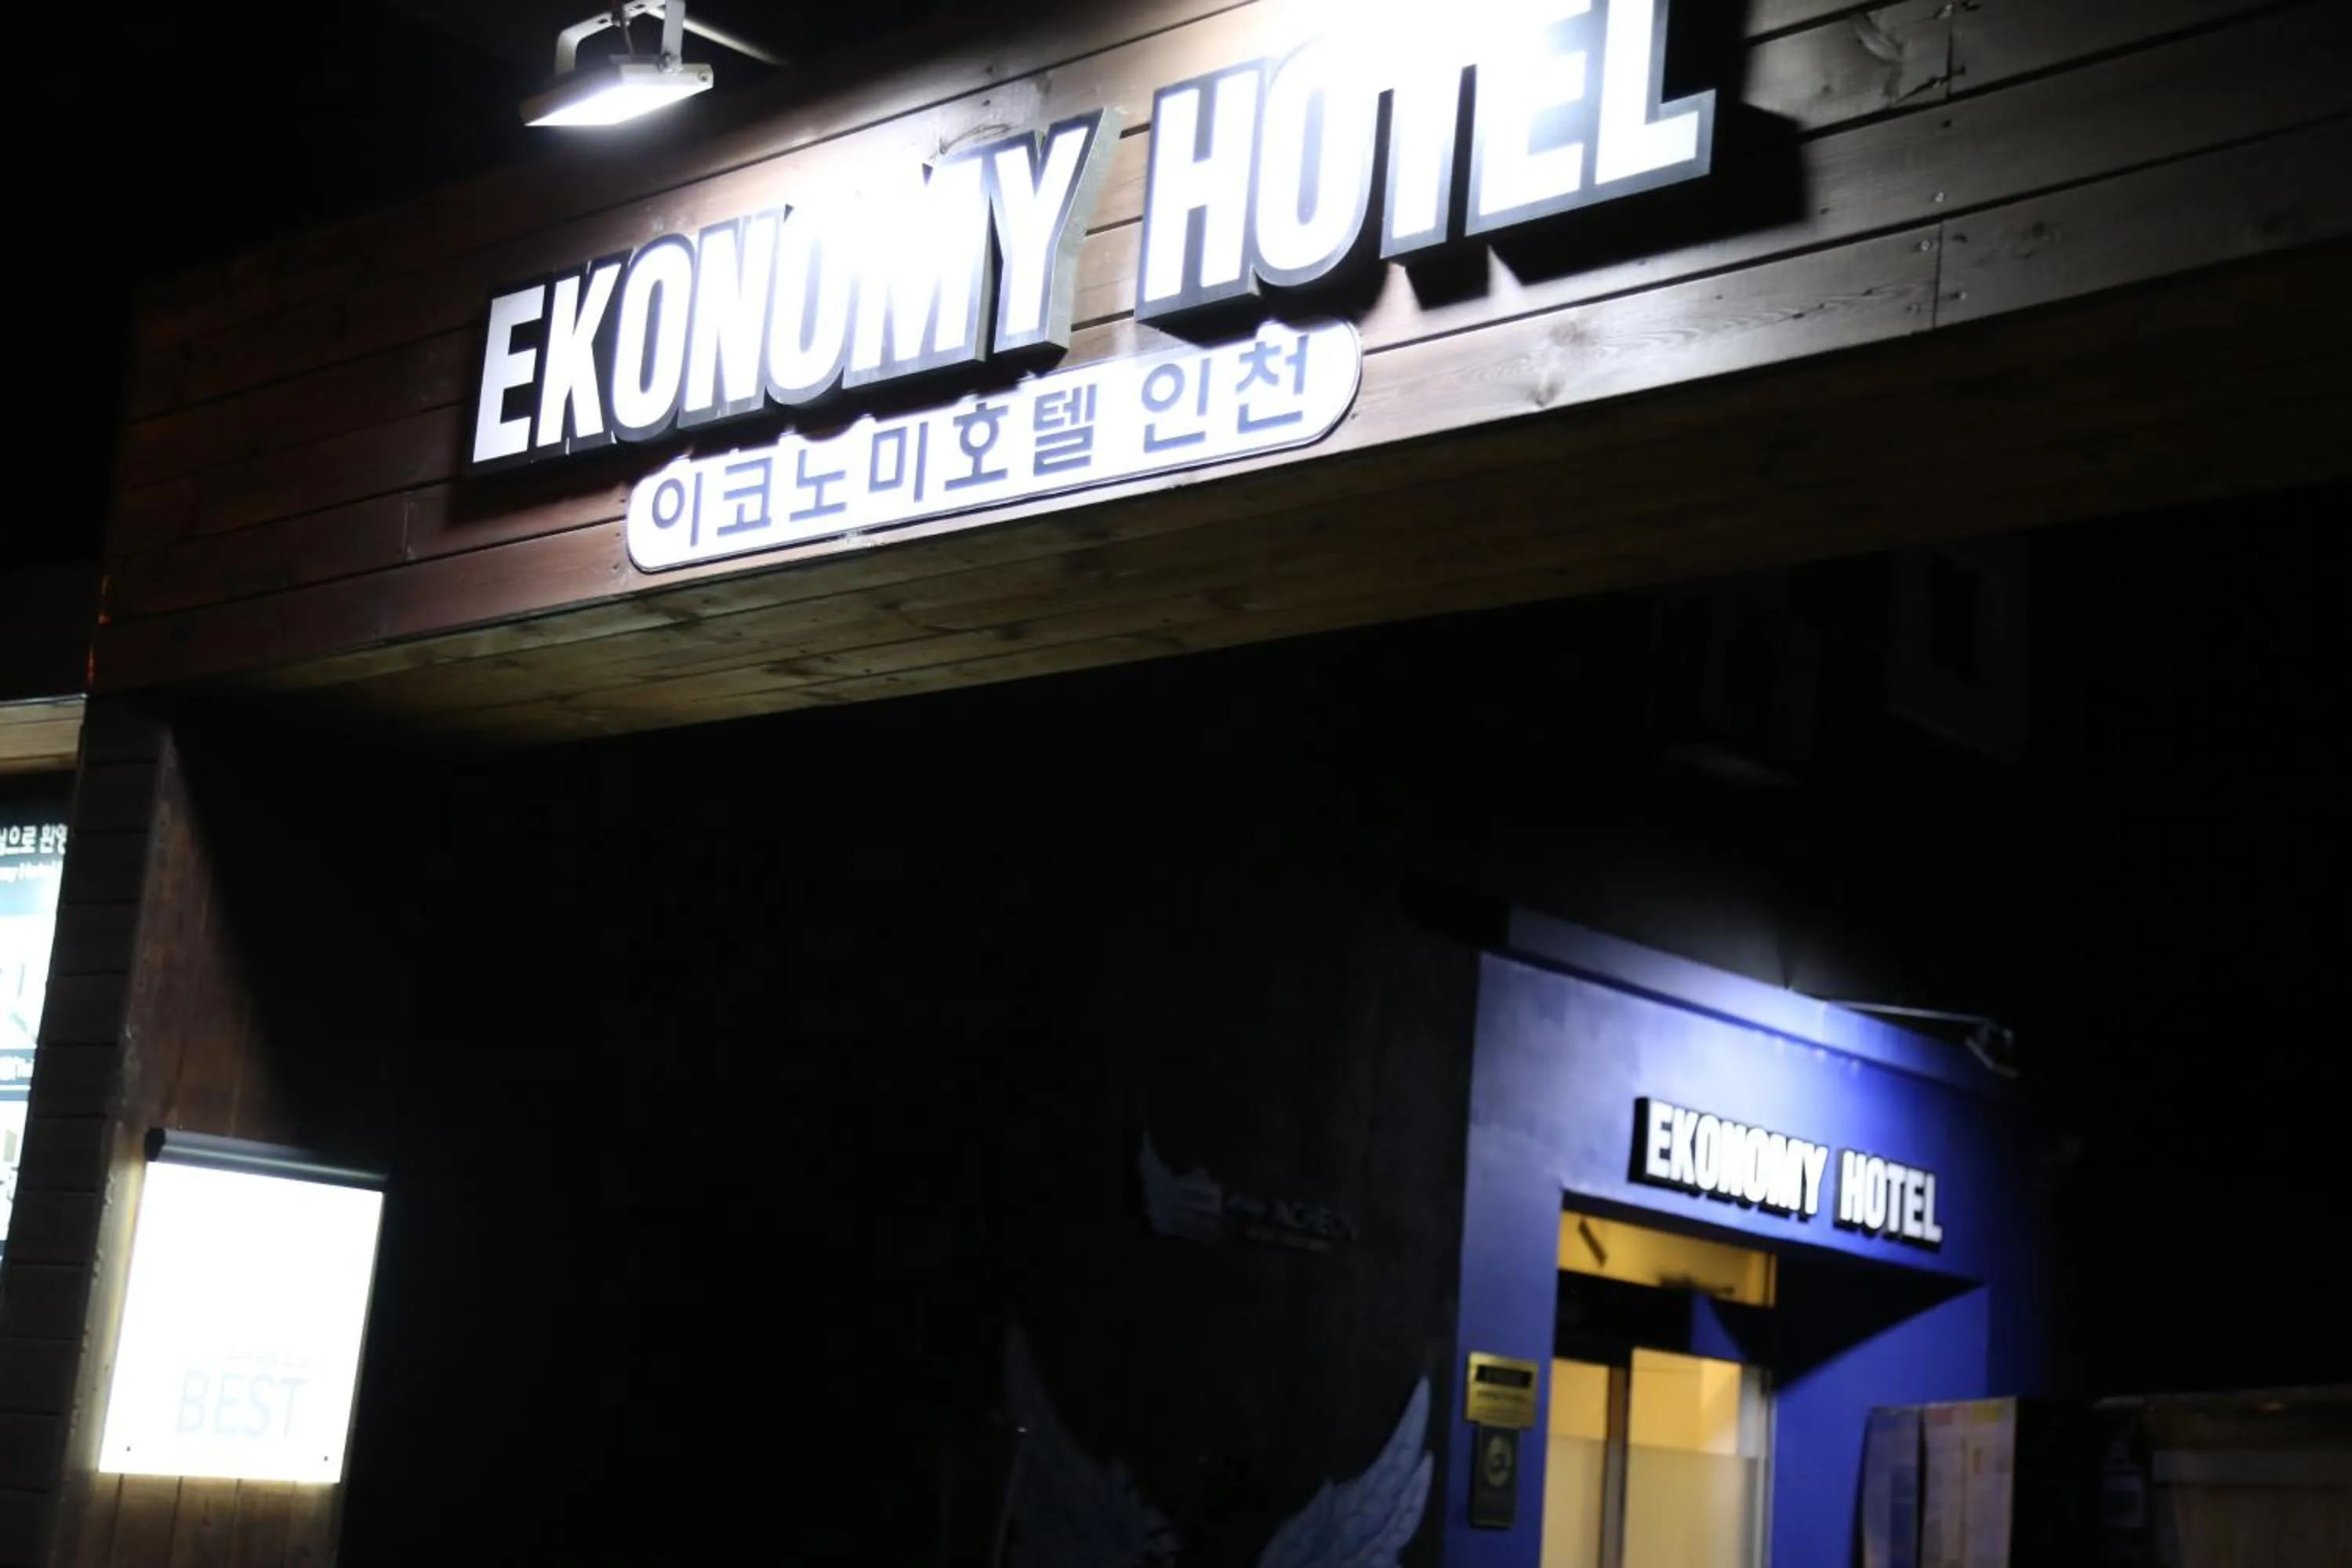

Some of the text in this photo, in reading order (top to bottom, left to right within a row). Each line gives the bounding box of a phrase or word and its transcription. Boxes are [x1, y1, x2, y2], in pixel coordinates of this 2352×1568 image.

[470, 0, 1713, 466] EKONOMY HOTEL
[651, 328, 1309, 548] 이코노미호텔 인천
[0, 826, 36, 856] 으로
[1646, 1098, 1943, 1243] EKONOMY HOTEL
[175, 1368, 309, 1439] BEST
